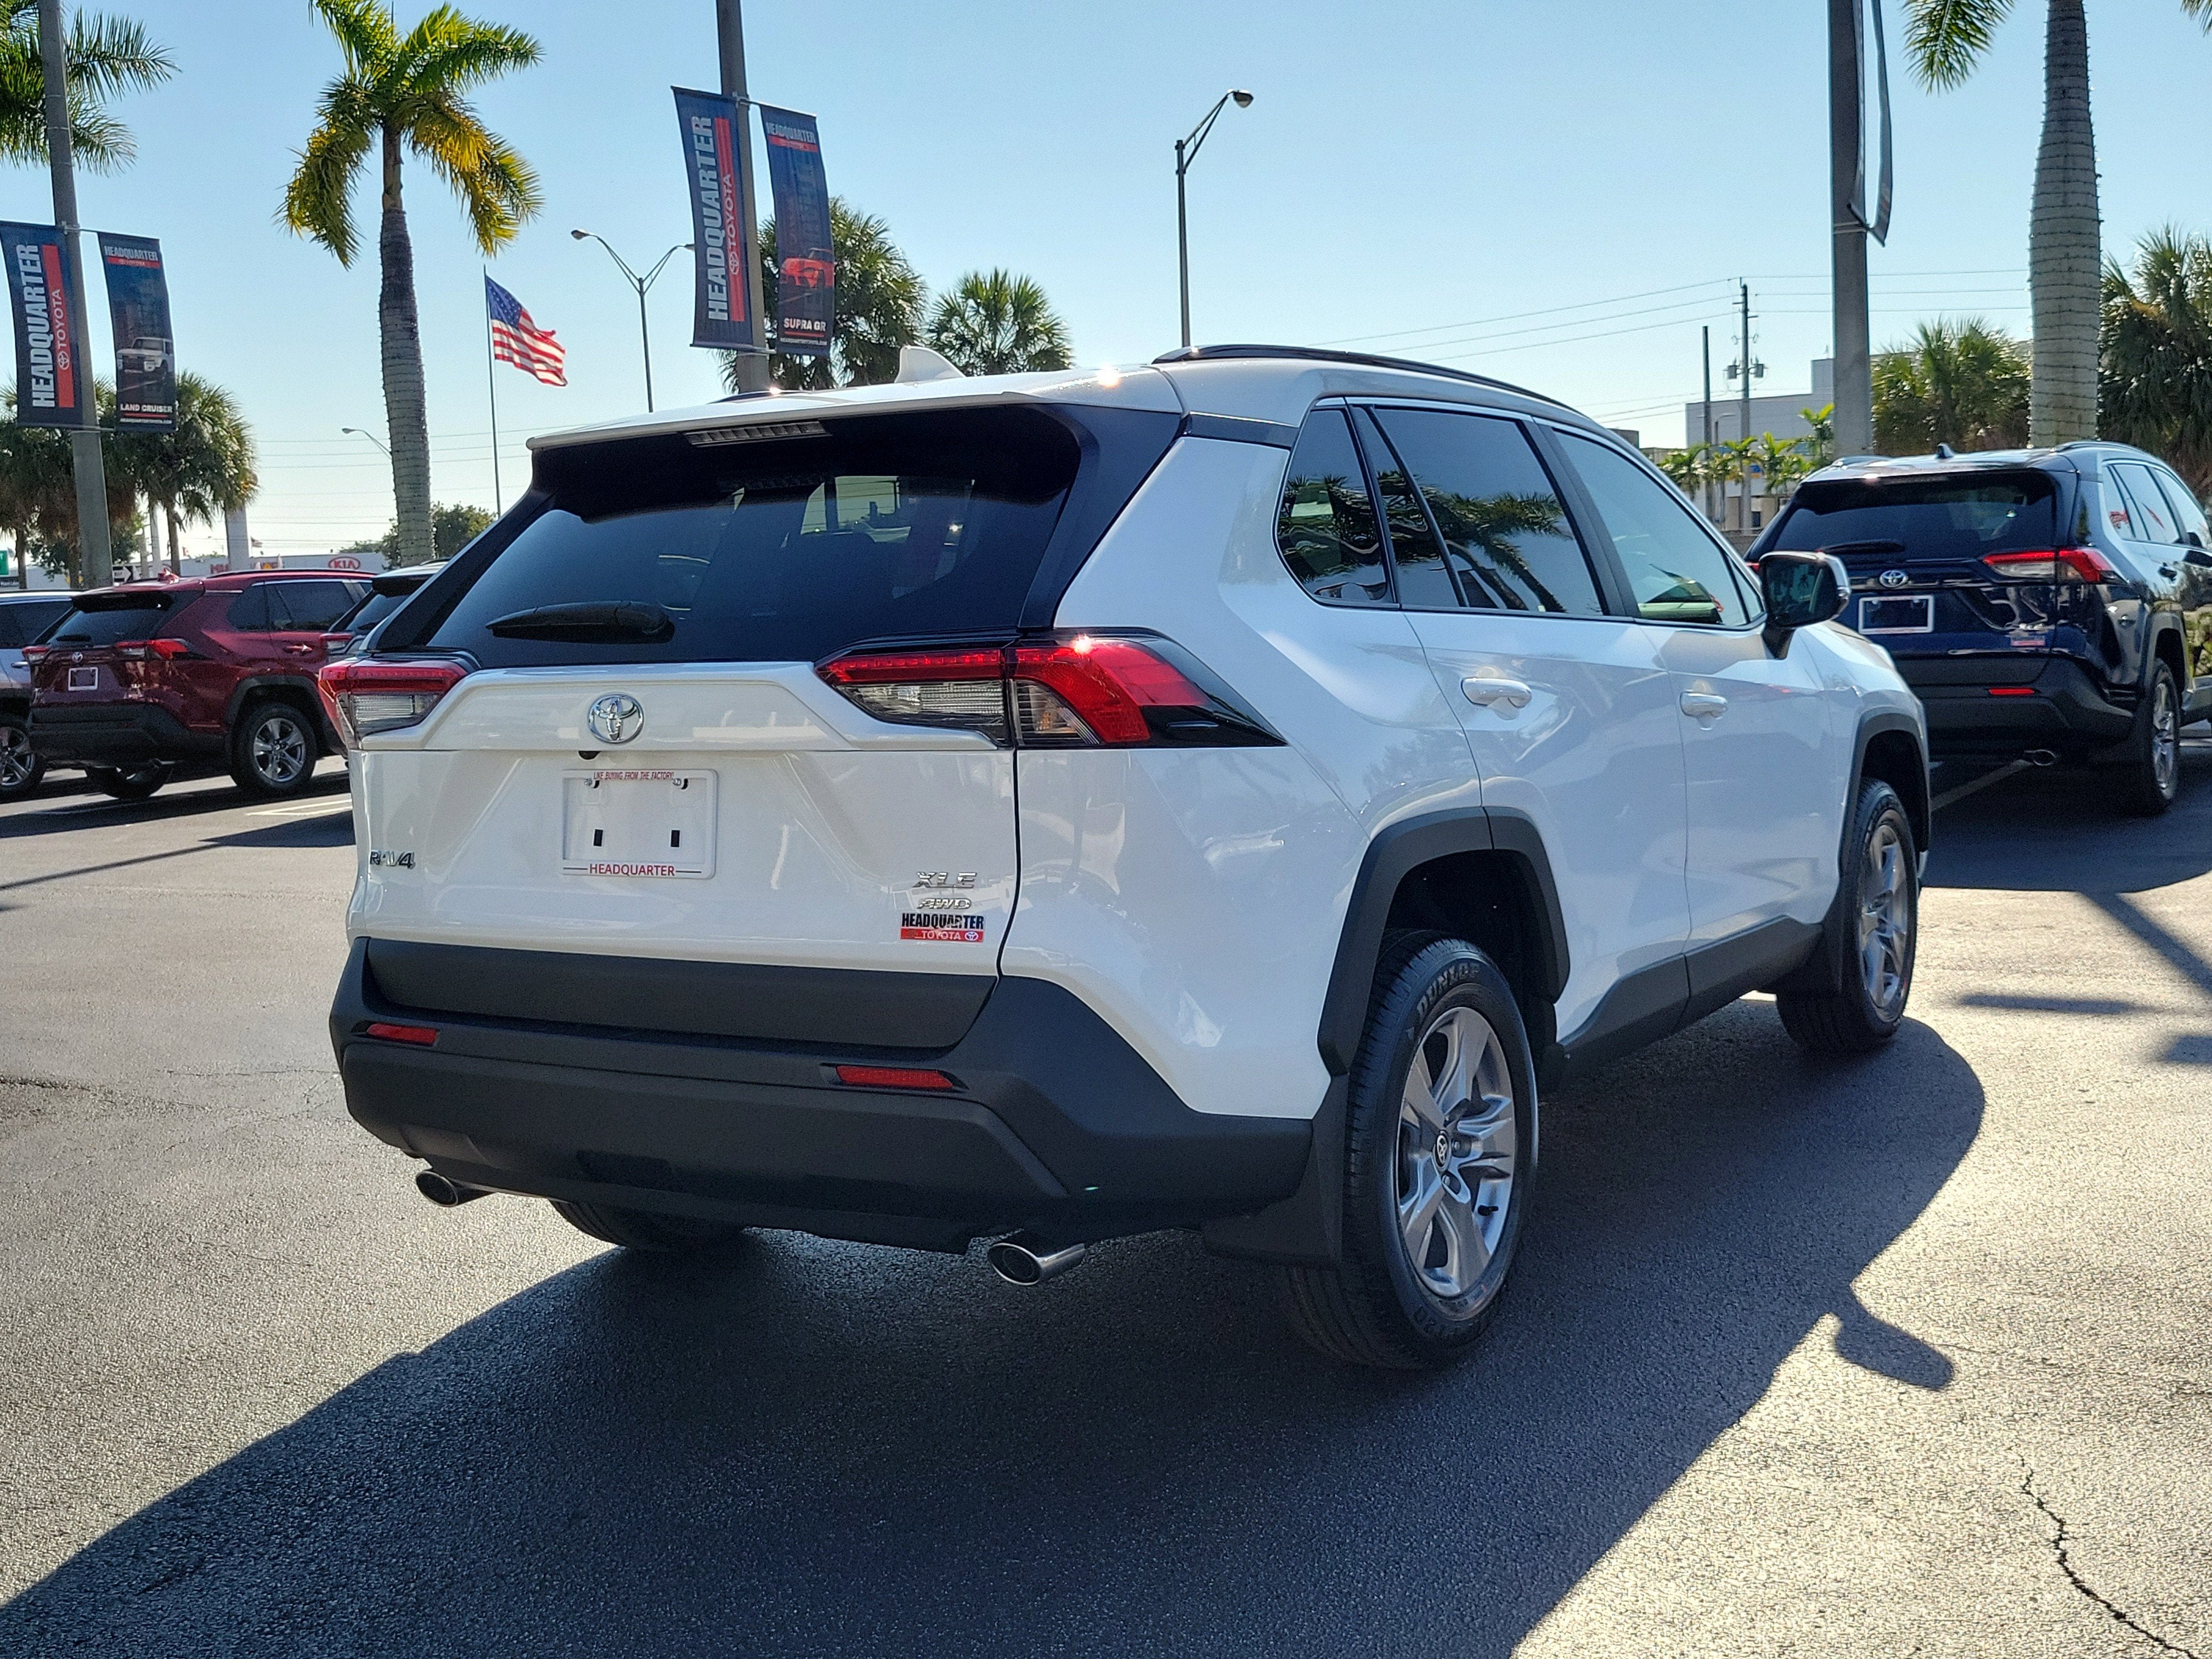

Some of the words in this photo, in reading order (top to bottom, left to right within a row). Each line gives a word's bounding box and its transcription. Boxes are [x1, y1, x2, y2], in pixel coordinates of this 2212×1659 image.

[765, 122, 816, 144] HEADQUARTER
[691, 116, 729, 321] HEADQUARTER
[722, 174, 738, 251] TOYOTA
[104, 245, 159, 261] HEADQUARTER
[16, 245, 55, 408] HEADQUARTER
[52, 289, 67, 348] TOYOTA
[783, 318, 812, 330] SUPRA
[814, 320, 826, 332] GR
[141, 404, 173, 413] CRUISER
[594, 771, 603, 780] LIKE
[605, 771, 623, 780] BUYING
[625, 771, 639, 780] FROM
[640, 771, 650, 780] THE
[589, 864, 675, 876] HEADQUARTER
[912, 871, 977, 889] XLE
[917, 898, 972, 910] AWD
[901, 912, 985, 930] HEADQUARTER
[922, 931, 961, 940] TOYOTA
[1417, 962, 1480, 1025] DUNLOP
